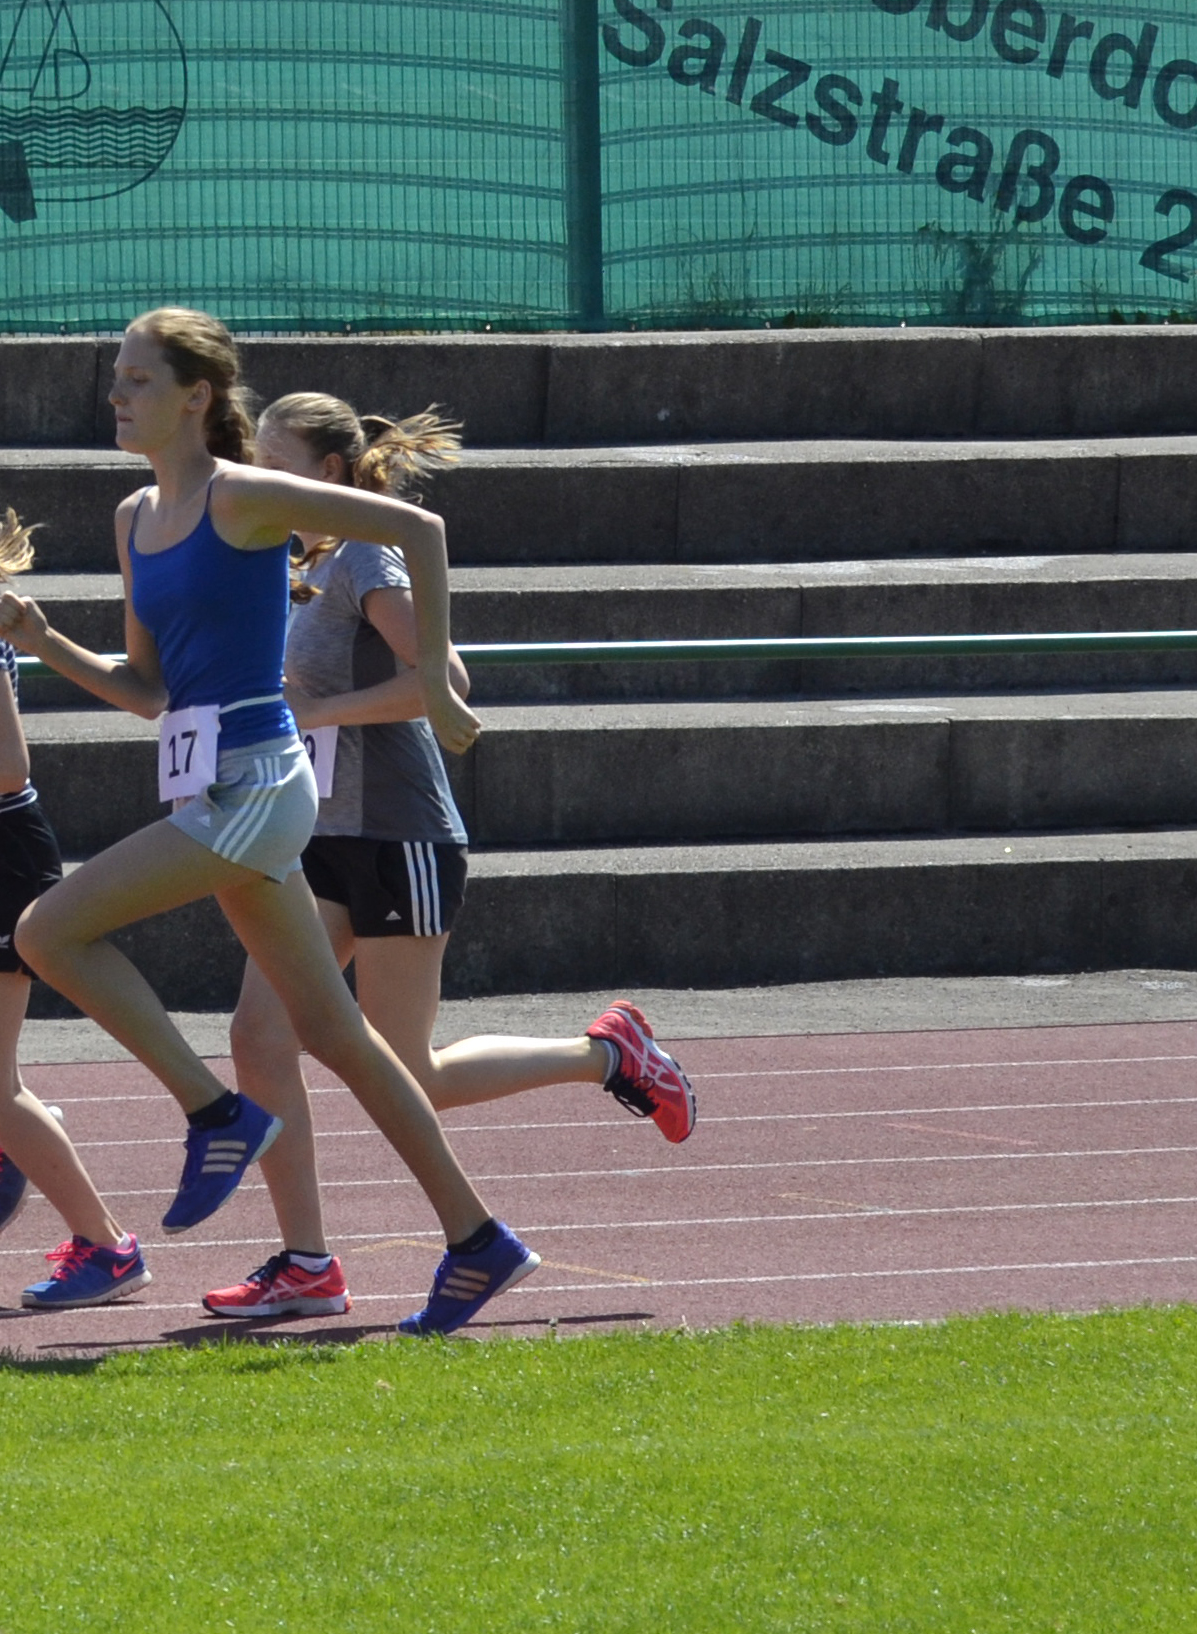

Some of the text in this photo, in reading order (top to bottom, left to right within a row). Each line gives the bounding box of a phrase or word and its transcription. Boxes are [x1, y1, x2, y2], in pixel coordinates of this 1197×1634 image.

[602, 0, 1115, 245] Salzstraße
[869, 0, 1197, 129] berdo
[168, 730, 198, 778] 17
